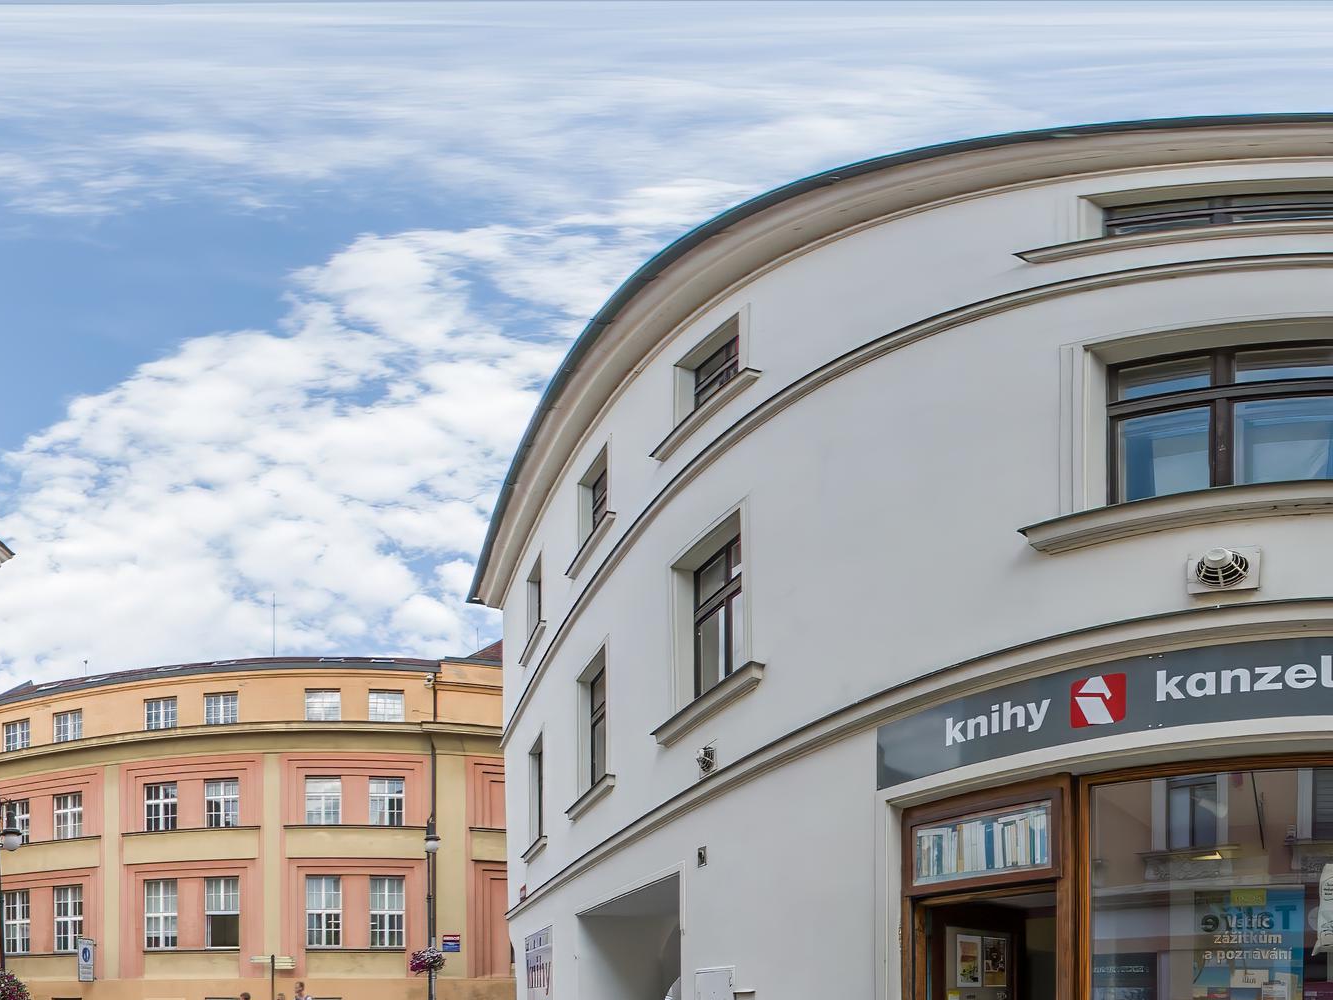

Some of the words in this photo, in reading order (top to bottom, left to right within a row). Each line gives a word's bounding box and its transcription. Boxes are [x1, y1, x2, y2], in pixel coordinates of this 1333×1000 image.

[944, 698, 1052, 747] knihy
[1213, 930, 1282, 944] zážitkům
[1203, 951, 1213, 960] a
[1216, 947, 1293, 963] poznávání
